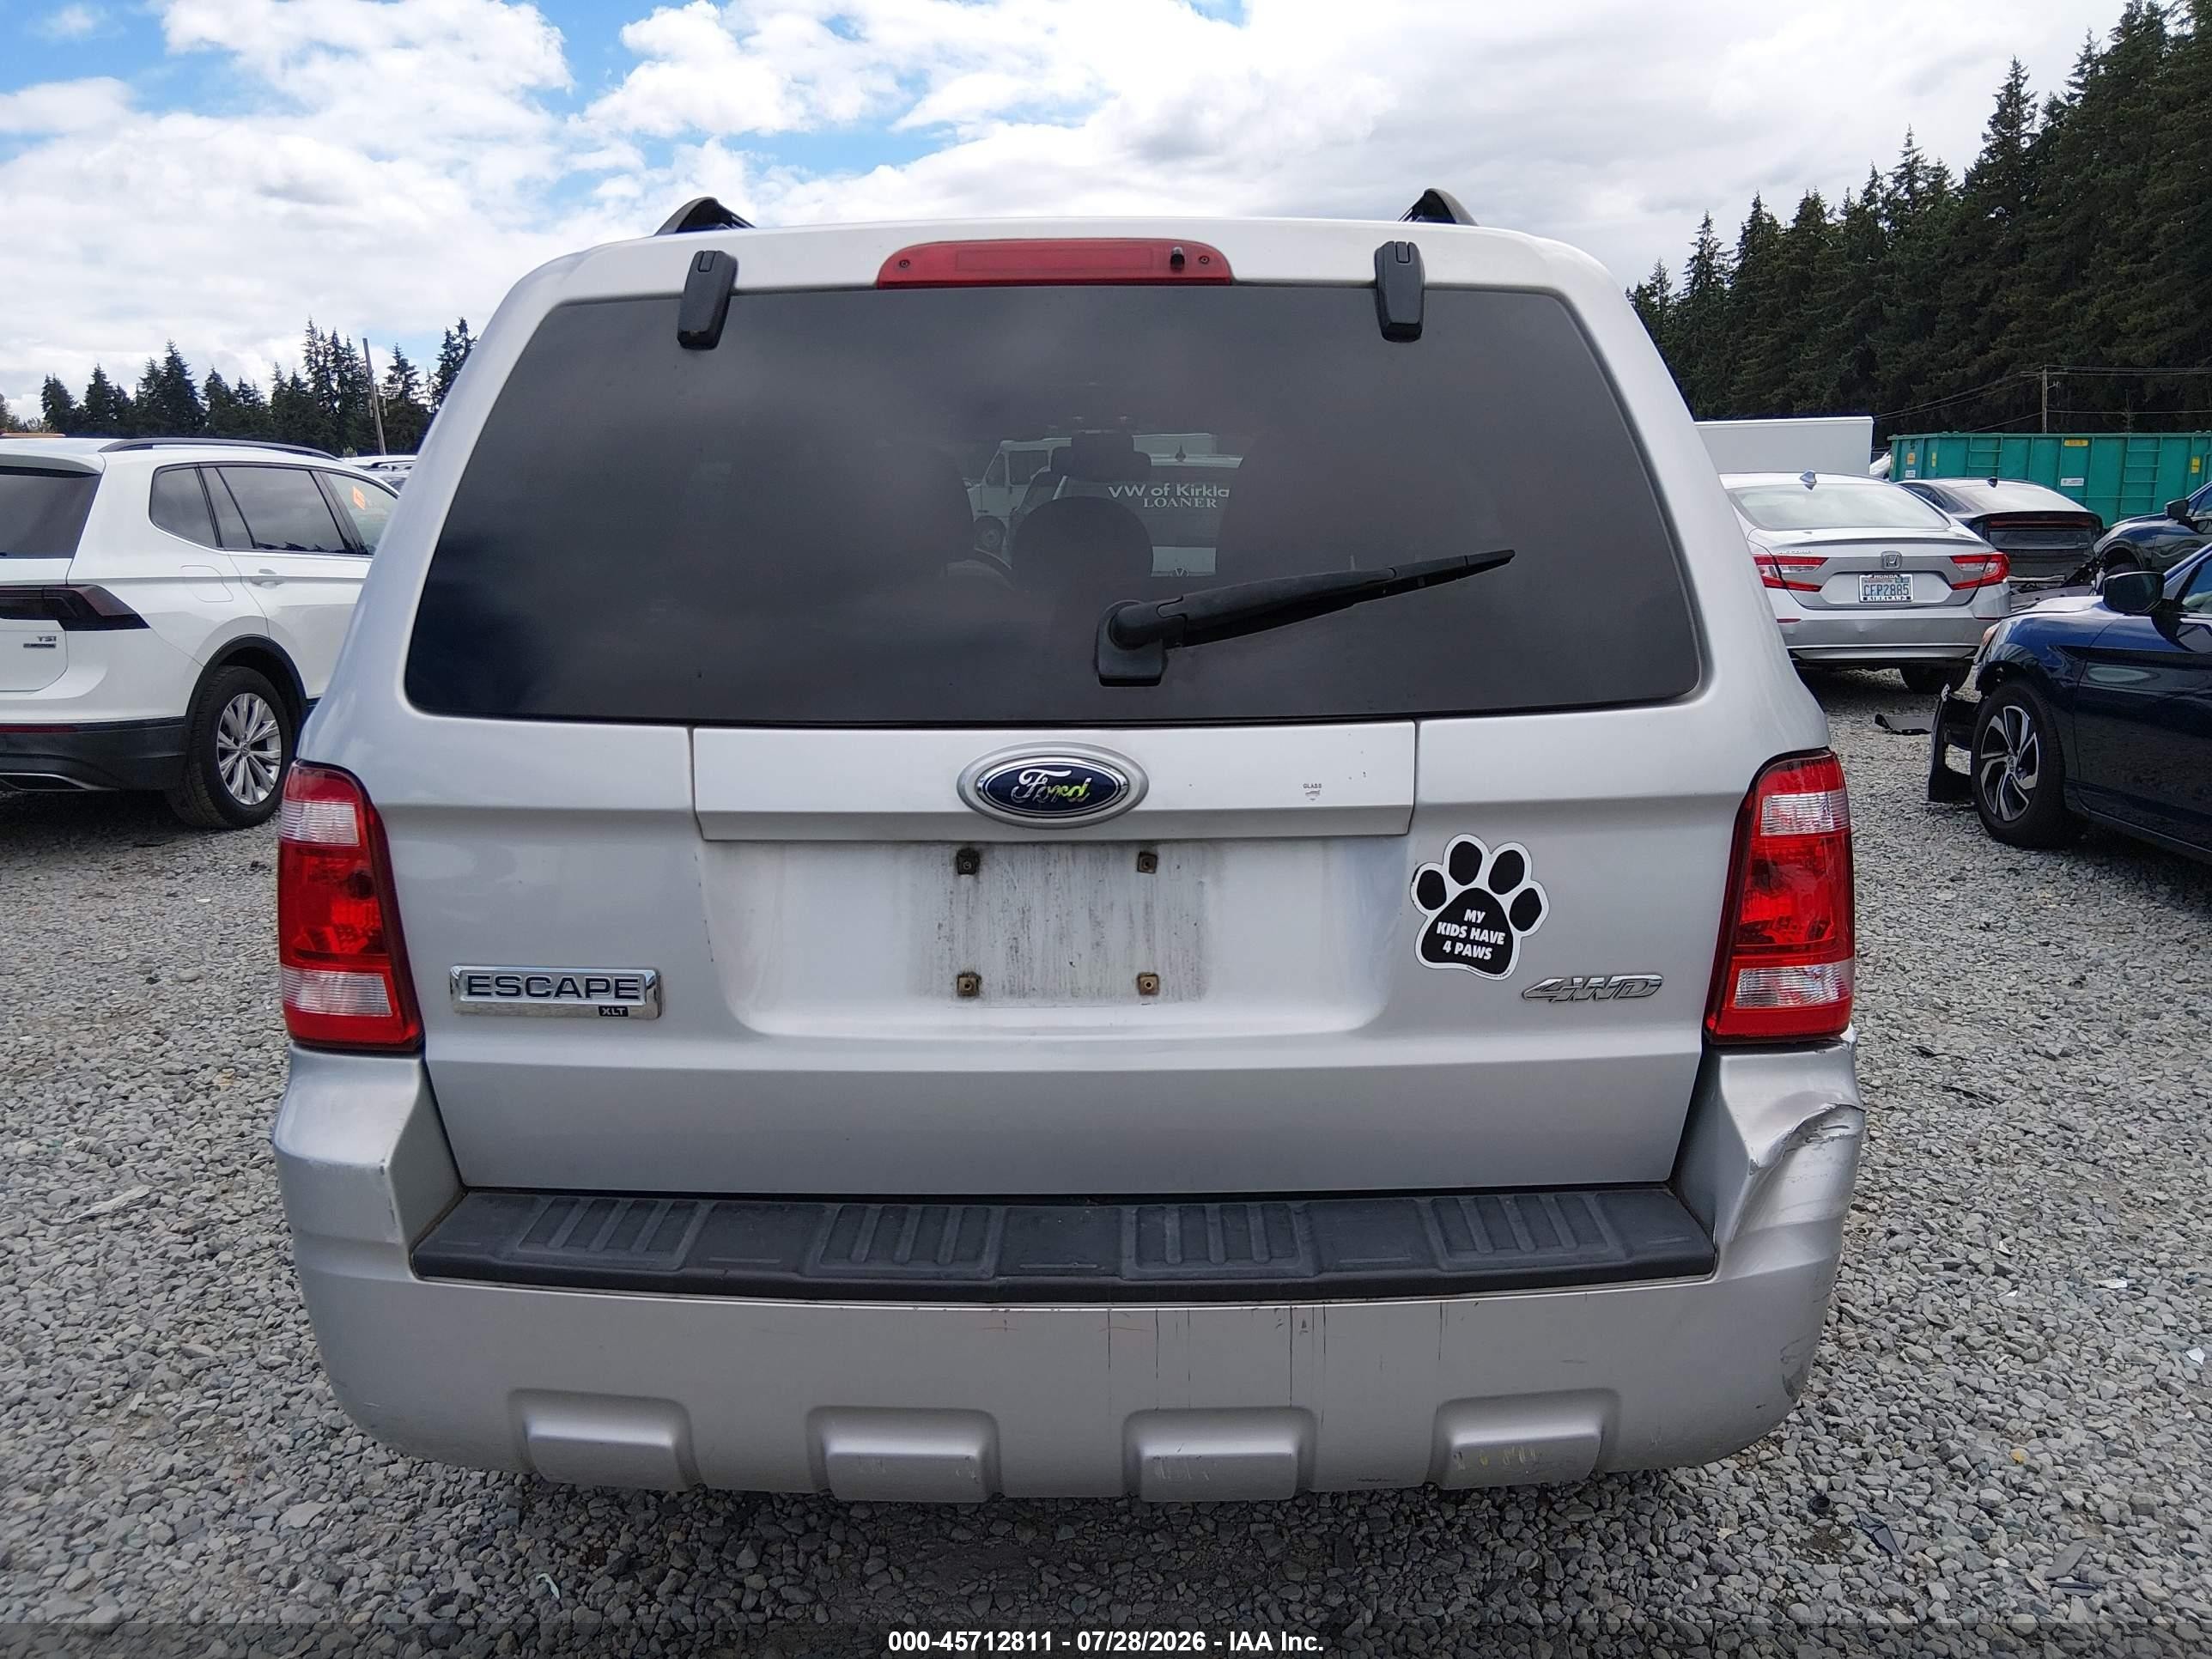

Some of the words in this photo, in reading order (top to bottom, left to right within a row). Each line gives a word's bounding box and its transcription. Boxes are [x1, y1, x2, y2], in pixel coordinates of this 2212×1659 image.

[1108, 484, 1146, 498] VW
[1151, 483, 1170, 496] of
[1143, 498, 1217, 508] LOANER
[1011, 769, 1092, 803] Ford
[1463, 908, 1486, 924] MY
[1436, 921, 1468, 939] KIDS
[1469, 927, 1506, 945] HAVE
[1443, 940, 1452, 953] 4
[1454, 941, 1493, 960] PAWS
[466, 973, 641, 1000] ESCAPE
[1522, 974, 1663, 1002] 4WD
[600, 1007, 626, 1017] XLT
